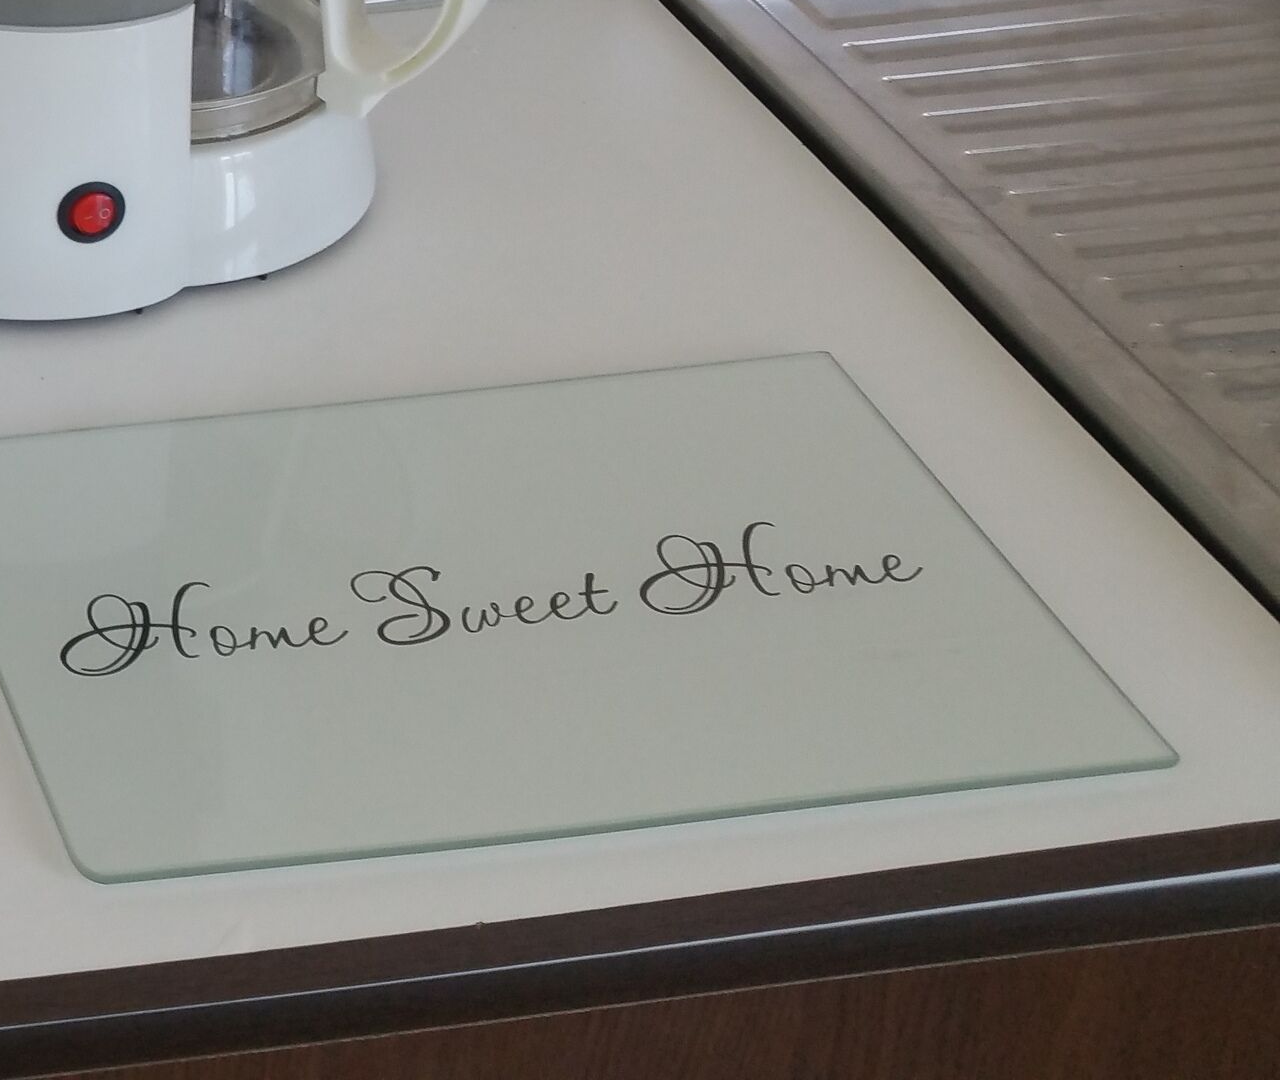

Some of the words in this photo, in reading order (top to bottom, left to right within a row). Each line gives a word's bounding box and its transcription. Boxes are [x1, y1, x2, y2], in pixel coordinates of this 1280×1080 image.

[59, 581, 349, 677] Home
[350, 566, 619, 646] Sweet
[639, 521, 923, 616] Home
